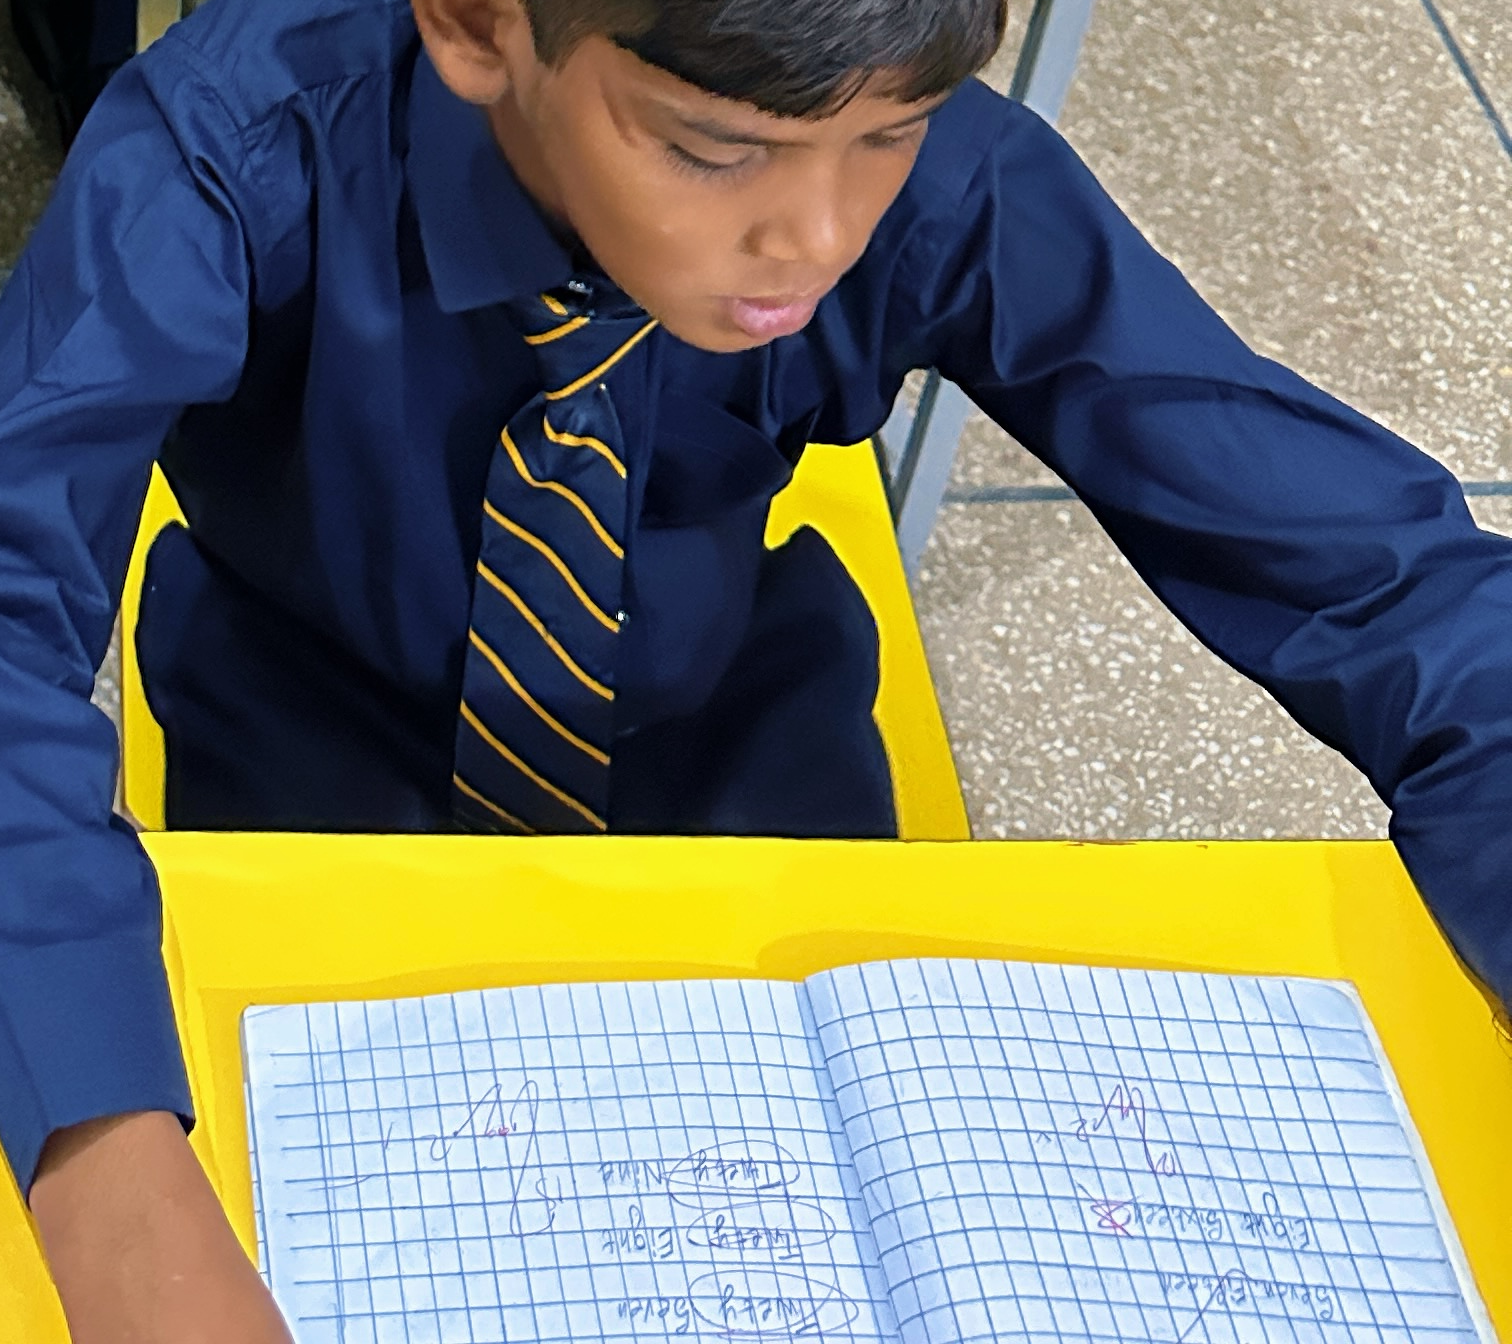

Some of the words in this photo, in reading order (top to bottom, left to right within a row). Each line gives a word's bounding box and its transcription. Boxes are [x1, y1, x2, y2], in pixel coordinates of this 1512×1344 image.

[597, 1160, 663, 1191] Nine
[600, 1205, 674, 1259] Eight
[616, 1297, 694, 1334] Seven
